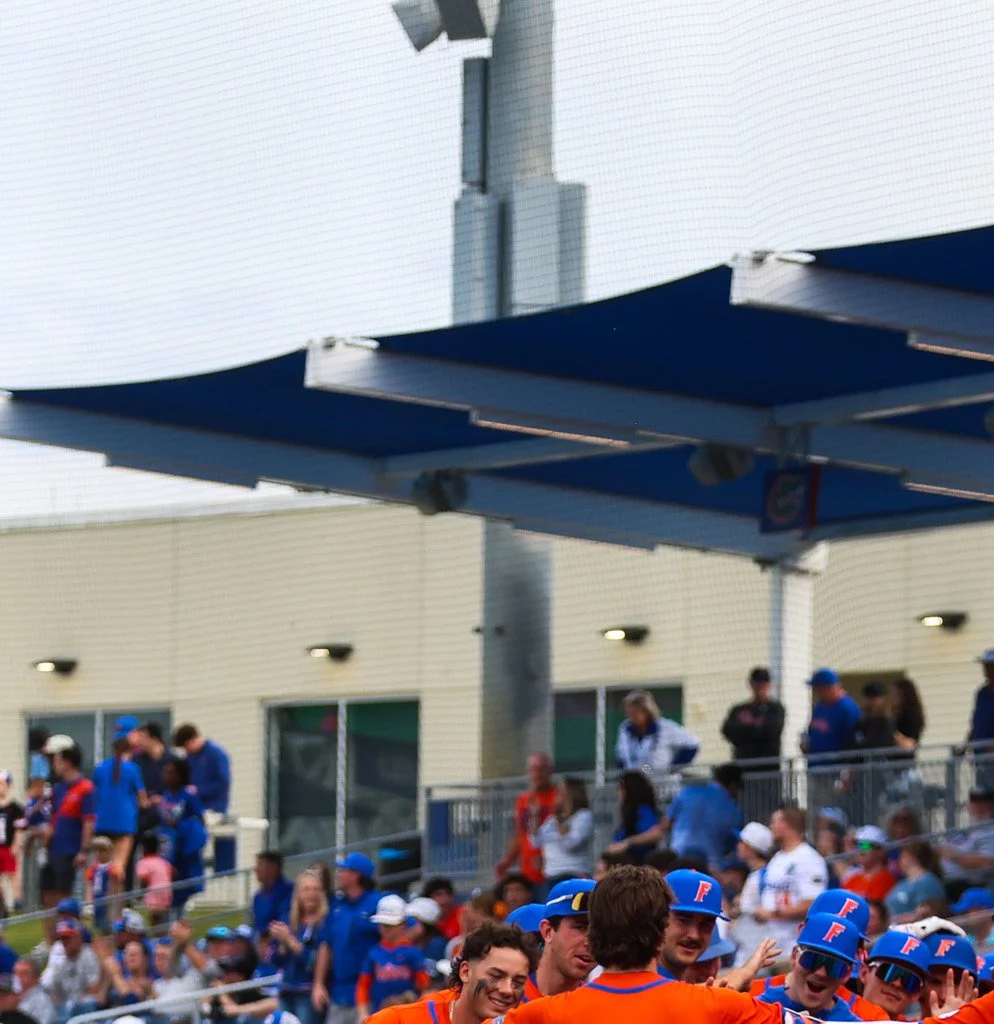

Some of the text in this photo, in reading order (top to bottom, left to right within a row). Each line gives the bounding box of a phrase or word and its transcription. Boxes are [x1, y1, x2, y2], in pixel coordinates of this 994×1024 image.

[694, 880, 713, 902] F
[838, 898, 859, 918] F
[822, 921, 846, 943] F
[901, 936, 920, 955] F
[934, 938, 956, 957] F
